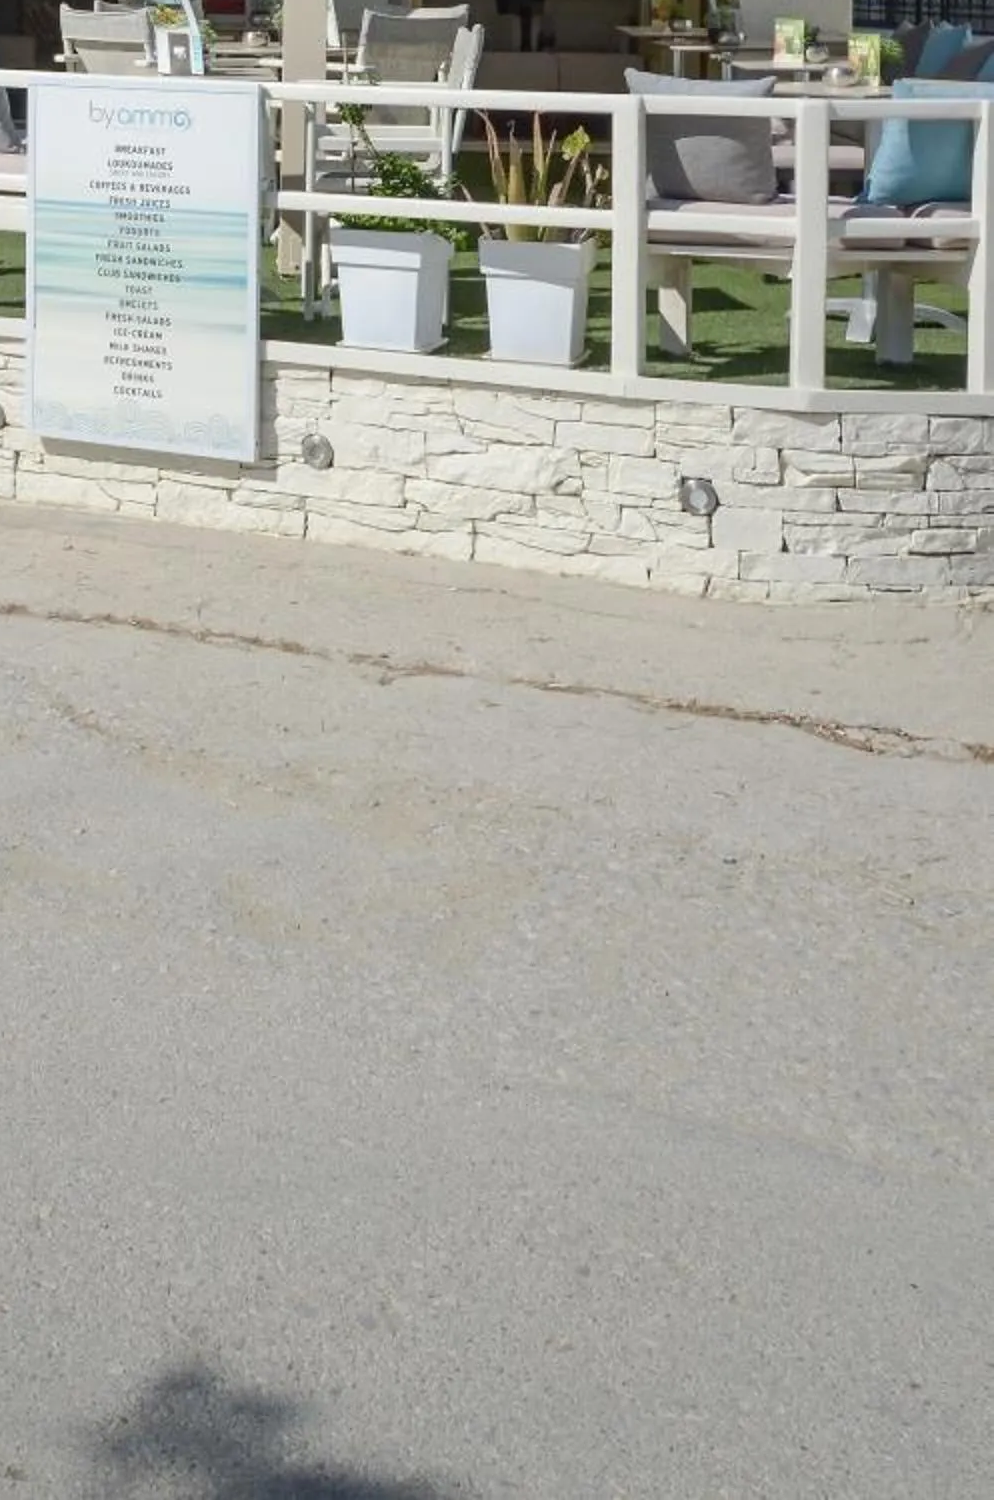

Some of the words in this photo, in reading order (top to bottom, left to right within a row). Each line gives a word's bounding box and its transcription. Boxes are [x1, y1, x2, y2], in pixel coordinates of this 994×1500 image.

[114, 144, 166, 156] BREAKFAST
[107, 158, 173, 171] LOUKOUMADES
[89, 180, 127, 191] COFFEES
[139, 184, 191, 196] BEVERAGES
[109, 196, 136, 207] FRESH
[139, 198, 171, 209] JUICES
[114, 211, 165, 223] SMOOTHIES
[107, 240, 133, 250] FRUIT
[136, 242, 171, 253] SALADS
[95, 253, 123, 263] FRESH
[125, 255, 184, 269] SANDWICHES
[97, 267, 121, 278] CLUB
[123, 270, 182, 283] SANDWICHES
[125, 284, 153, 295] TOAST
[105, 311, 133, 323] FRESH
[136, 315, 173, 327] SALADS
[113, 328, 163, 341] ICE-CREAM
[109, 341, 129, 352] MILK
[132, 344, 167, 356] SHAKES
[103, 356, 173, 371] REFRESHMENTS
[121, 371, 155, 383] DRINKS
[113, 386, 164, 399] COCKTAILS
